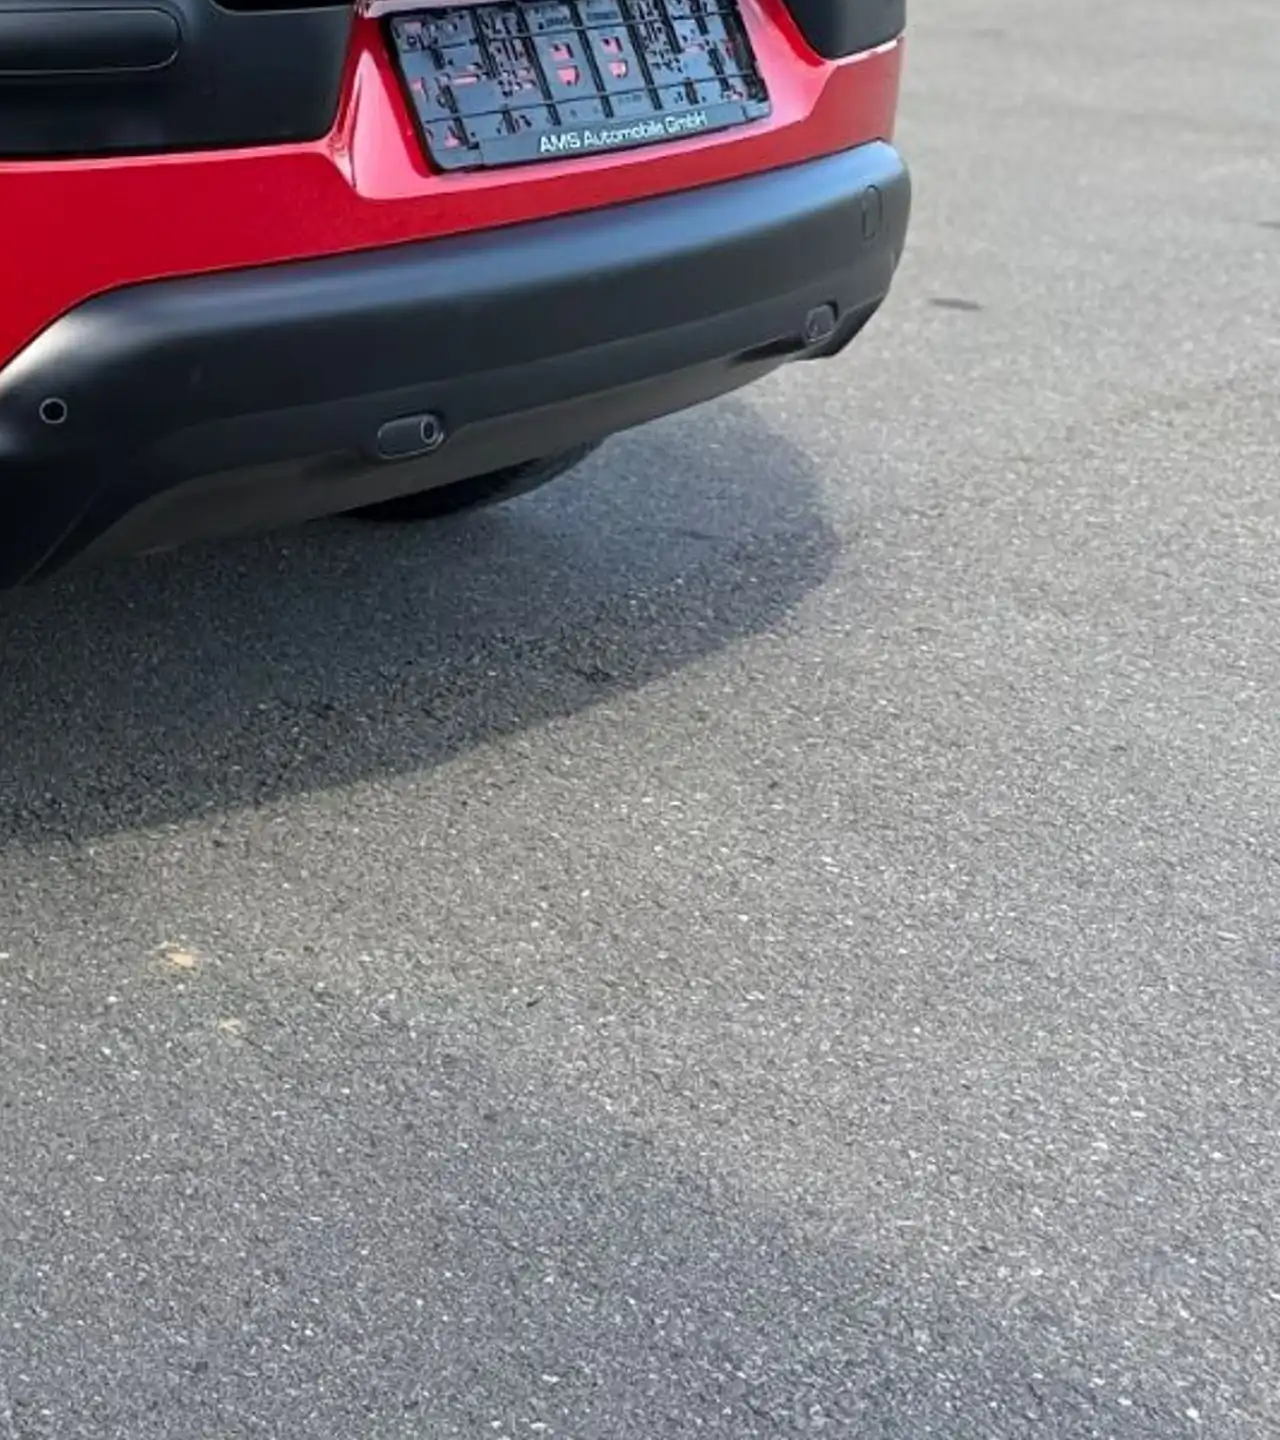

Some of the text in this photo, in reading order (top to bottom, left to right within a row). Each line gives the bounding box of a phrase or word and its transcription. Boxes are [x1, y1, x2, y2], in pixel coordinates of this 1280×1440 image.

[540, 111, 708, 153] AMS Automobile GmbH
